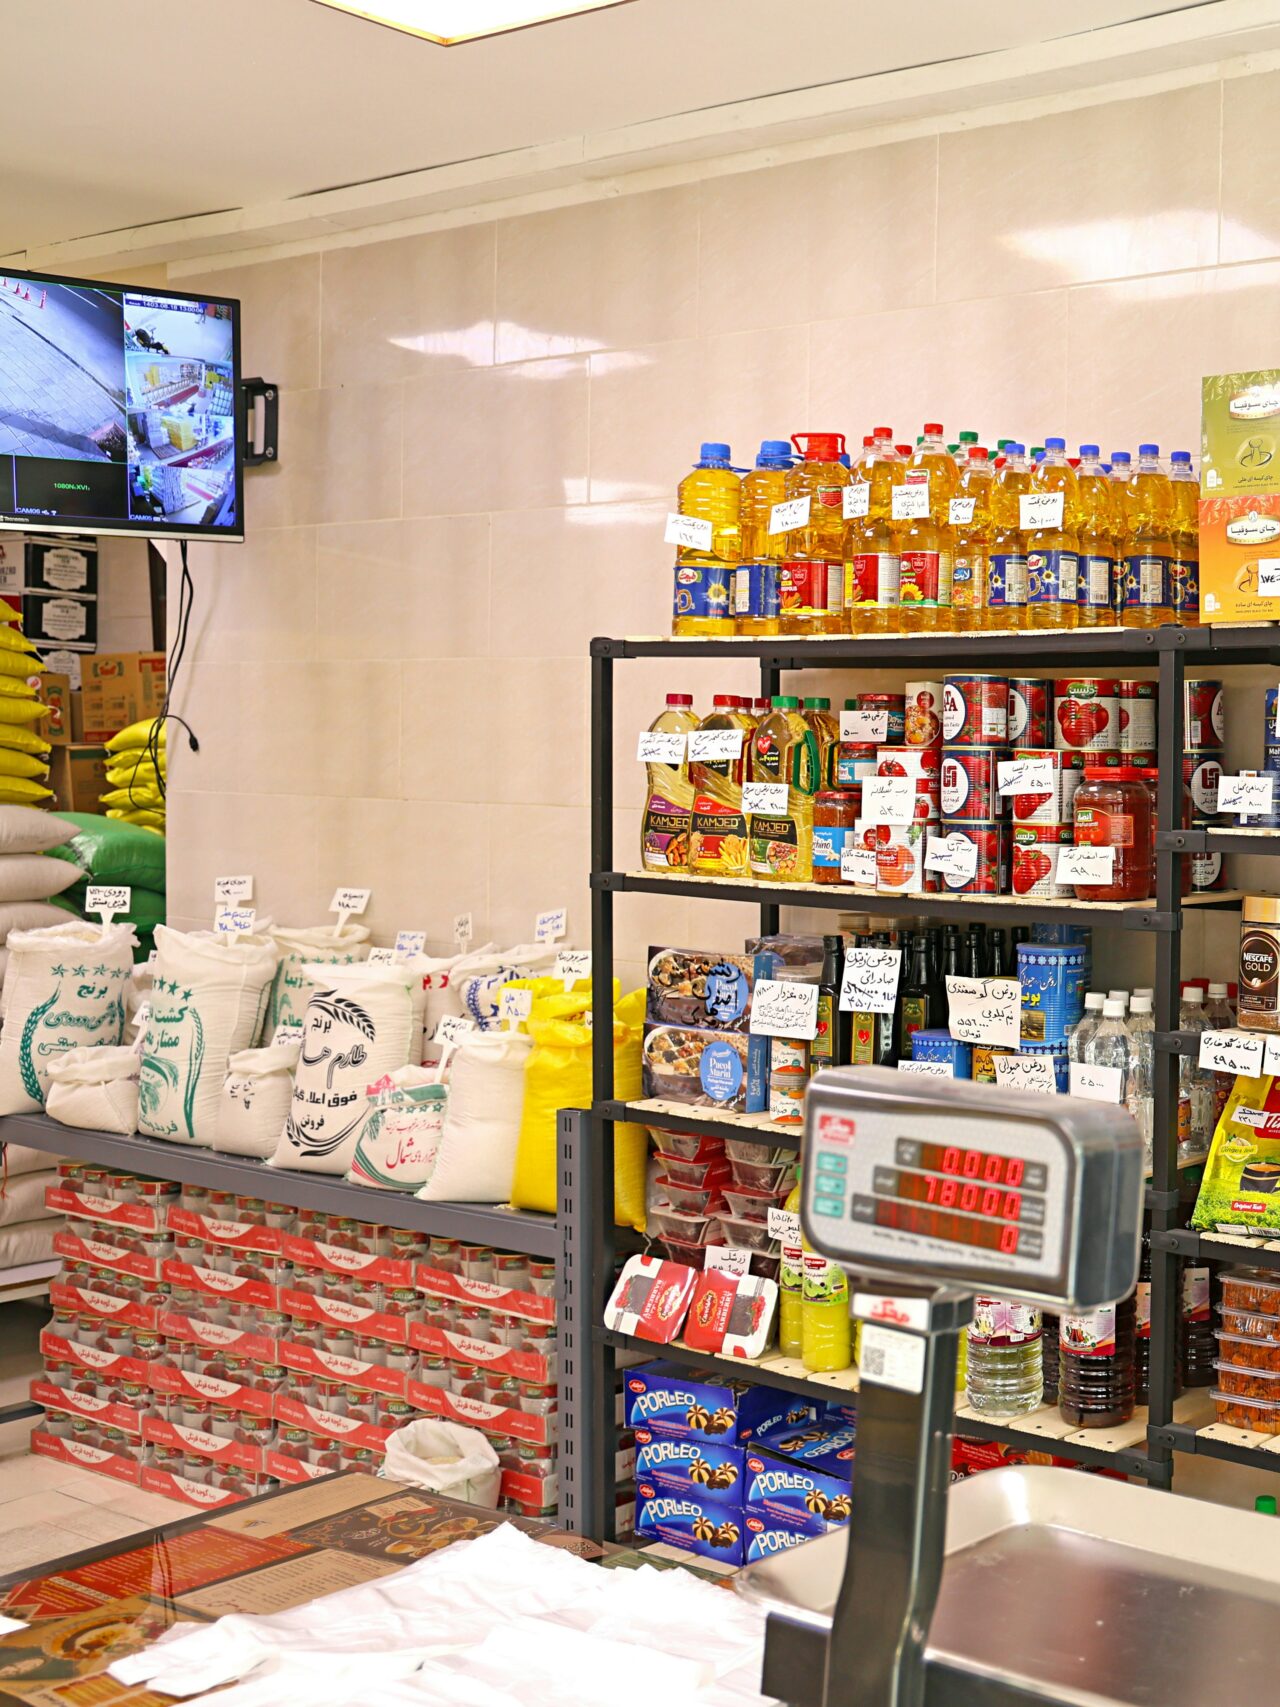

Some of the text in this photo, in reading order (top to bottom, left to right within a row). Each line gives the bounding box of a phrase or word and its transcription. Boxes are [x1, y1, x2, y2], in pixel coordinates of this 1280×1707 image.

[697, 816, 739, 829] KAMJED
[753, 819, 789, 833] KAMJED
[1243, 953, 1273, 964] NESCAFÉ
[1245, 962, 1270, 972] GOLD
[77, 983, 107, 1000] برنج
[311, 1015, 331, 1034] برنج
[328, 1090, 357, 1107] فوق
[386, 1138, 415, 1169] شمال
[1001, 1224, 1018, 1255] 0
[637, 1391, 696, 1417] PORLEO
[756, 1414, 783, 1437] PORLEO
[642, 1443, 700, 1468] PORLEO
[756, 1472, 814, 1496] PORLEO
[646, 1499, 702, 1523] PORLEO
